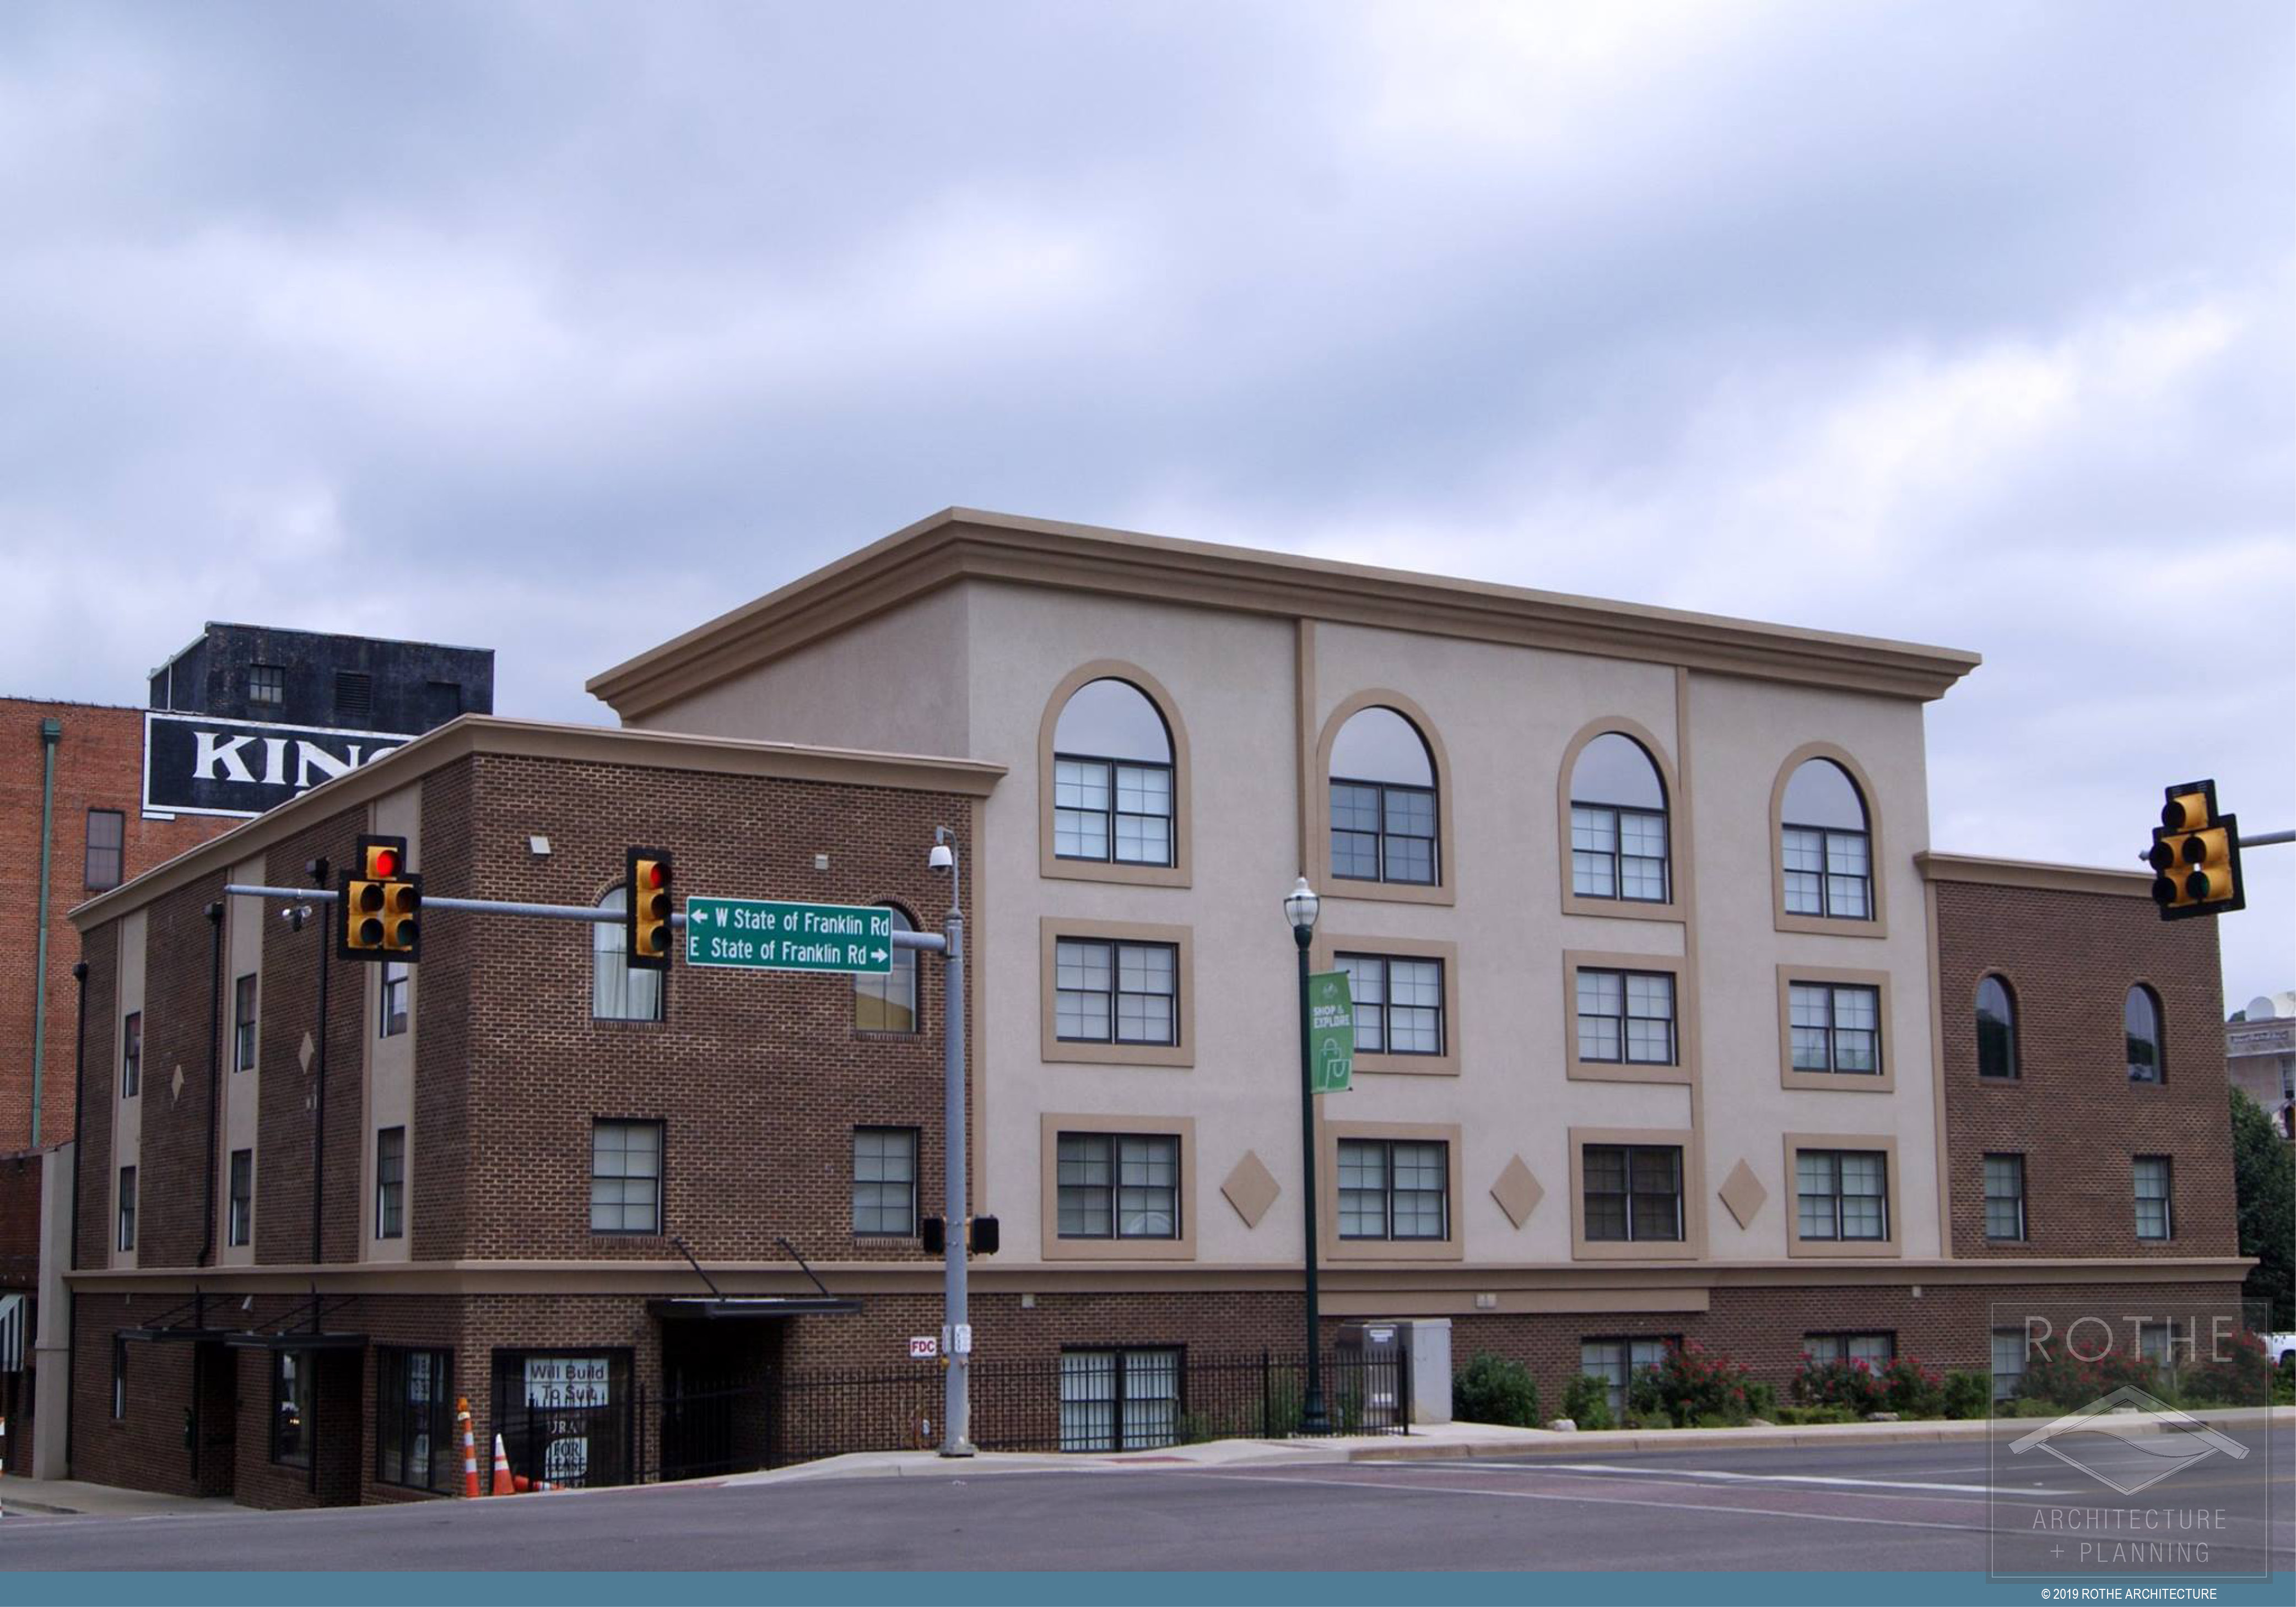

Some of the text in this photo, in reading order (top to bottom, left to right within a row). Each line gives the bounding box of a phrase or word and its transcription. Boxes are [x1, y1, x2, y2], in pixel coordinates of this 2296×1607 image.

[192, 732, 399, 787] KIN
[715, 908, 889, 937] W State of Franklin Rd
[690, 937, 866, 964] E State of Franklin Rd
[912, 1341, 934, 1352] FDC
[532, 1365, 604, 1379] Will Build
[543, 1384, 559, 1400] To
[554, 1442, 579, 1457] FOR
